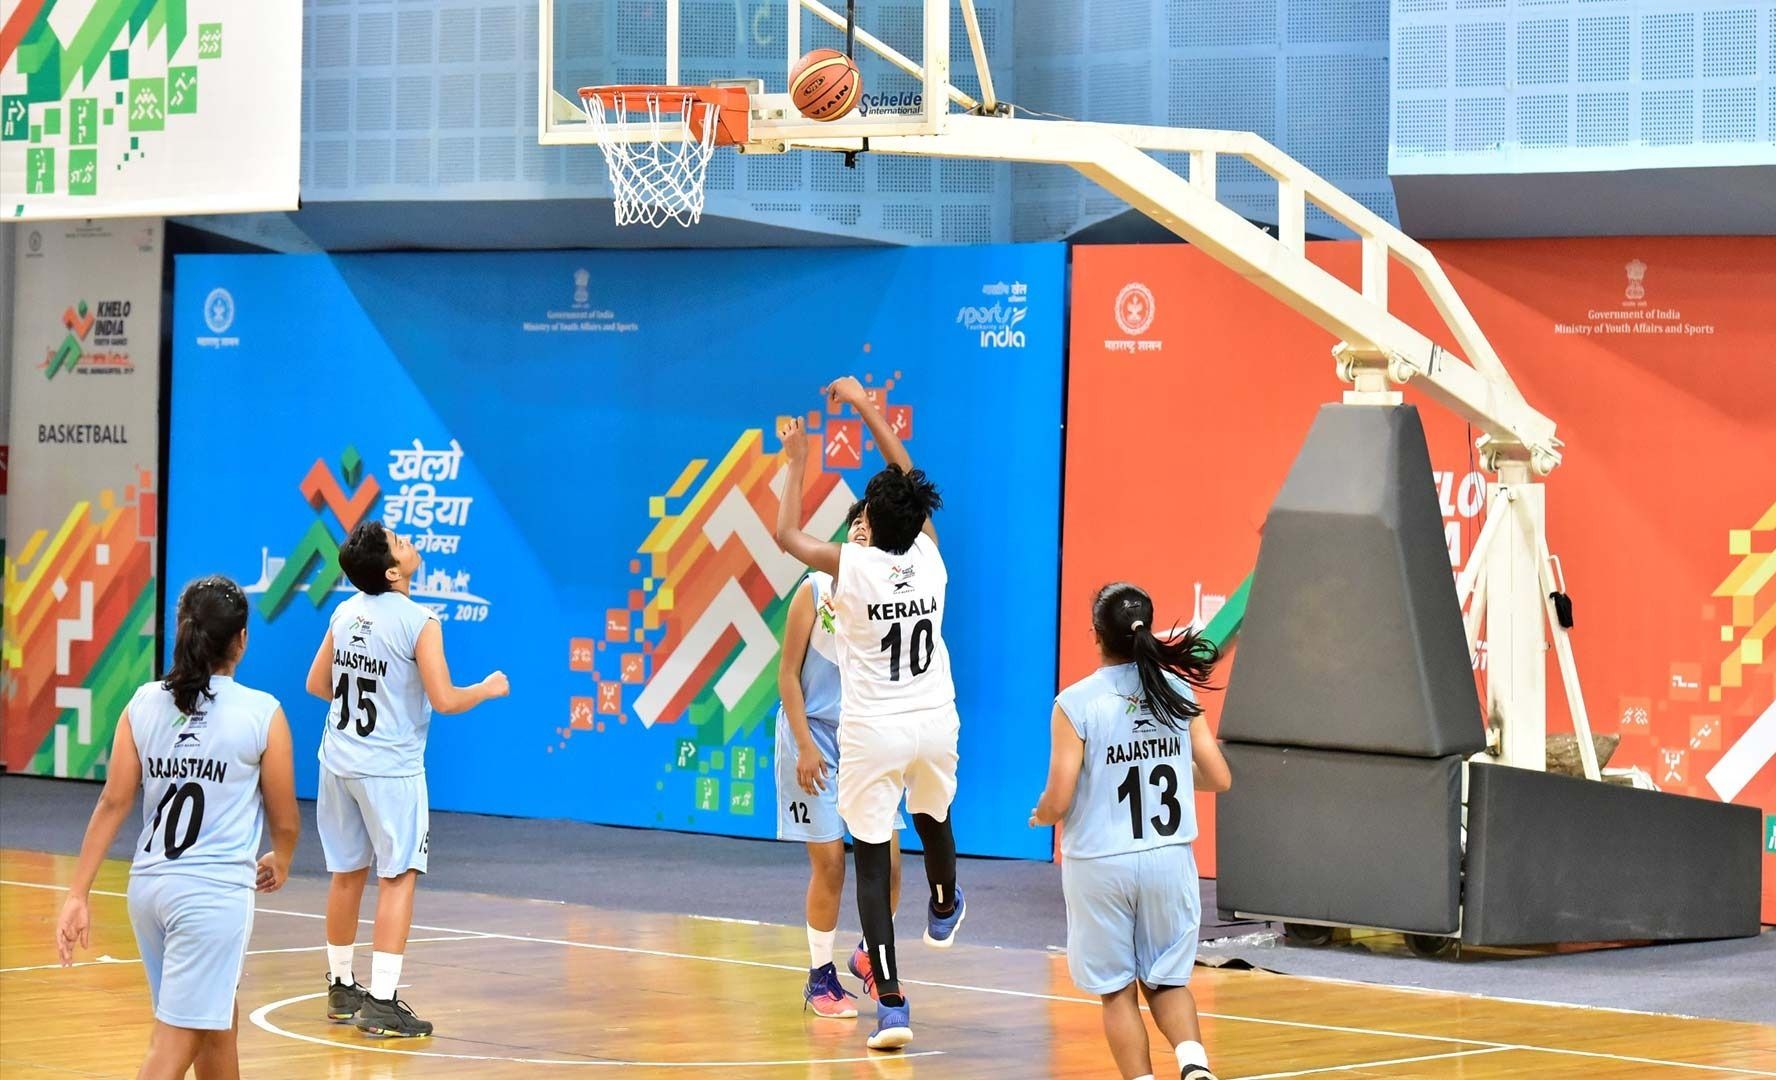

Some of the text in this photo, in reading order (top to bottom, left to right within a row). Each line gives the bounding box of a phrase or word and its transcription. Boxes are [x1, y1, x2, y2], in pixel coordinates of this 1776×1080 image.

[859, 91, 922, 115] Schelde
[869, 106, 921, 115] international
[97, 301, 131, 317] KHELO
[1588, 309, 1680, 320] Government of India
[95, 319, 124, 335] INDIA
[980, 325, 1026, 348] india
[1554, 324, 1714, 336] Ministry of Youth Affairs and Sports
[38, 424, 128, 444] BASKETBALL
[388, 438, 464, 481] खेलो
[382, 483, 473, 529] इंडिया
[454, 603, 489, 622] 2019
[867, 595, 938, 621] KERALA
[881, 618, 935, 681] 10
[333, 648, 388, 677] AJASTHAN
[334, 672, 377, 737] 15
[1106, 736, 1181, 765] RAJASTHAN
[789, 801, 811, 824] 12
[1117, 763, 1182, 839] 13
[144, 781, 205, 860] 10
